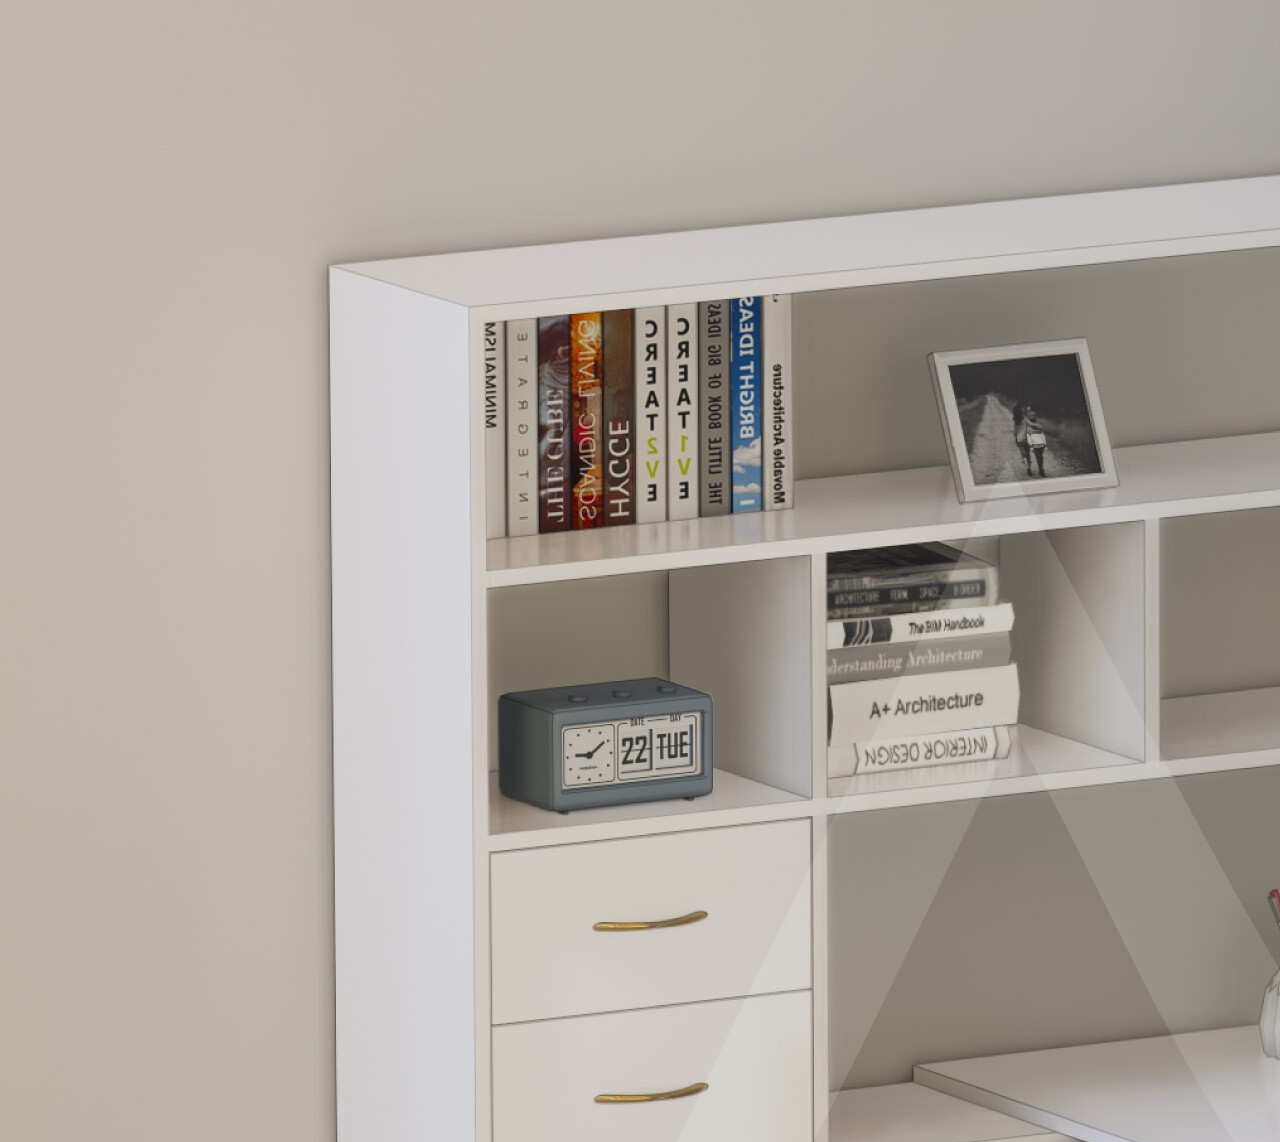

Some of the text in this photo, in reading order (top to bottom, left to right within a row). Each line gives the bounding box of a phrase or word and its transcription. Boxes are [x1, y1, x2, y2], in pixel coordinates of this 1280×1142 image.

[908, 614, 986, 636] The BIM Handbook
[827, 648, 984, 675] nderstanding Architecture
[869, 691, 985, 720] A+ Architecture
[630, 713, 682, 727] DATE DAY
[622, 731, 688, 765] 22 TUE
[864, 734, 988, 768] INTERIOR DESIGN
